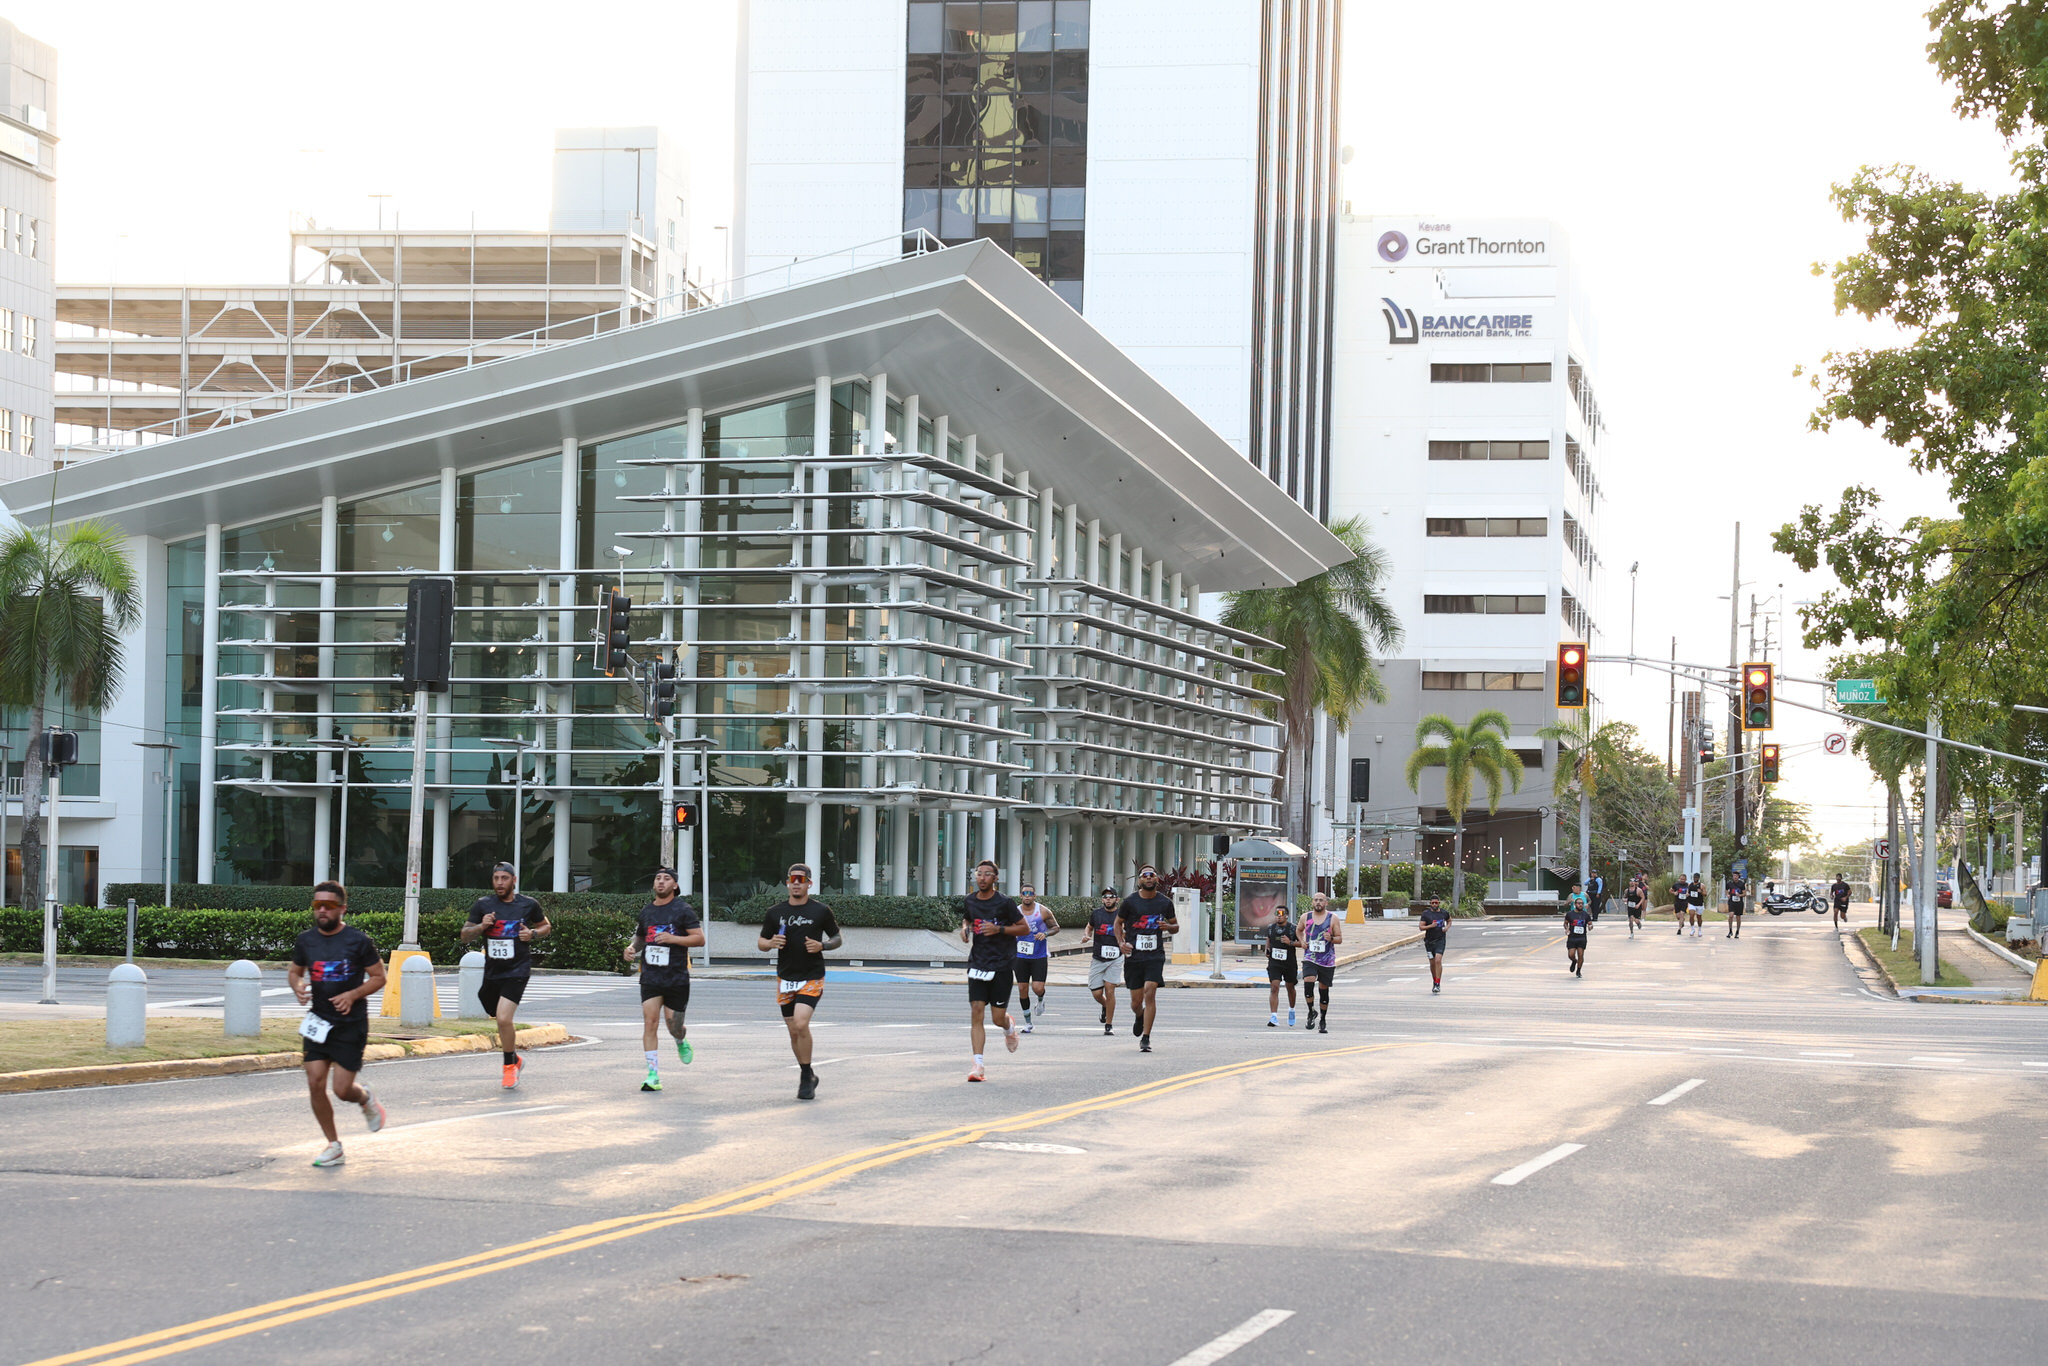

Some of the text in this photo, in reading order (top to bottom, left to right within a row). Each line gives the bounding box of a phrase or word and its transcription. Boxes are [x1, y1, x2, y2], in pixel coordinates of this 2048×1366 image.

[1418, 222, 1451, 232] Kevane
[1415, 236, 1545, 255] Grant Thornton
[1422, 315, 1532, 329] BANCARIBE
[1421, 328, 1532, 338] International Bank, Inc.
[1839, 689, 1870, 701] MUÑOZ
[1140, 941, 1153, 949] 108
[492, 948, 508, 957] 213
[651, 954, 660, 963] 71
[785, 981, 799, 990] 191
